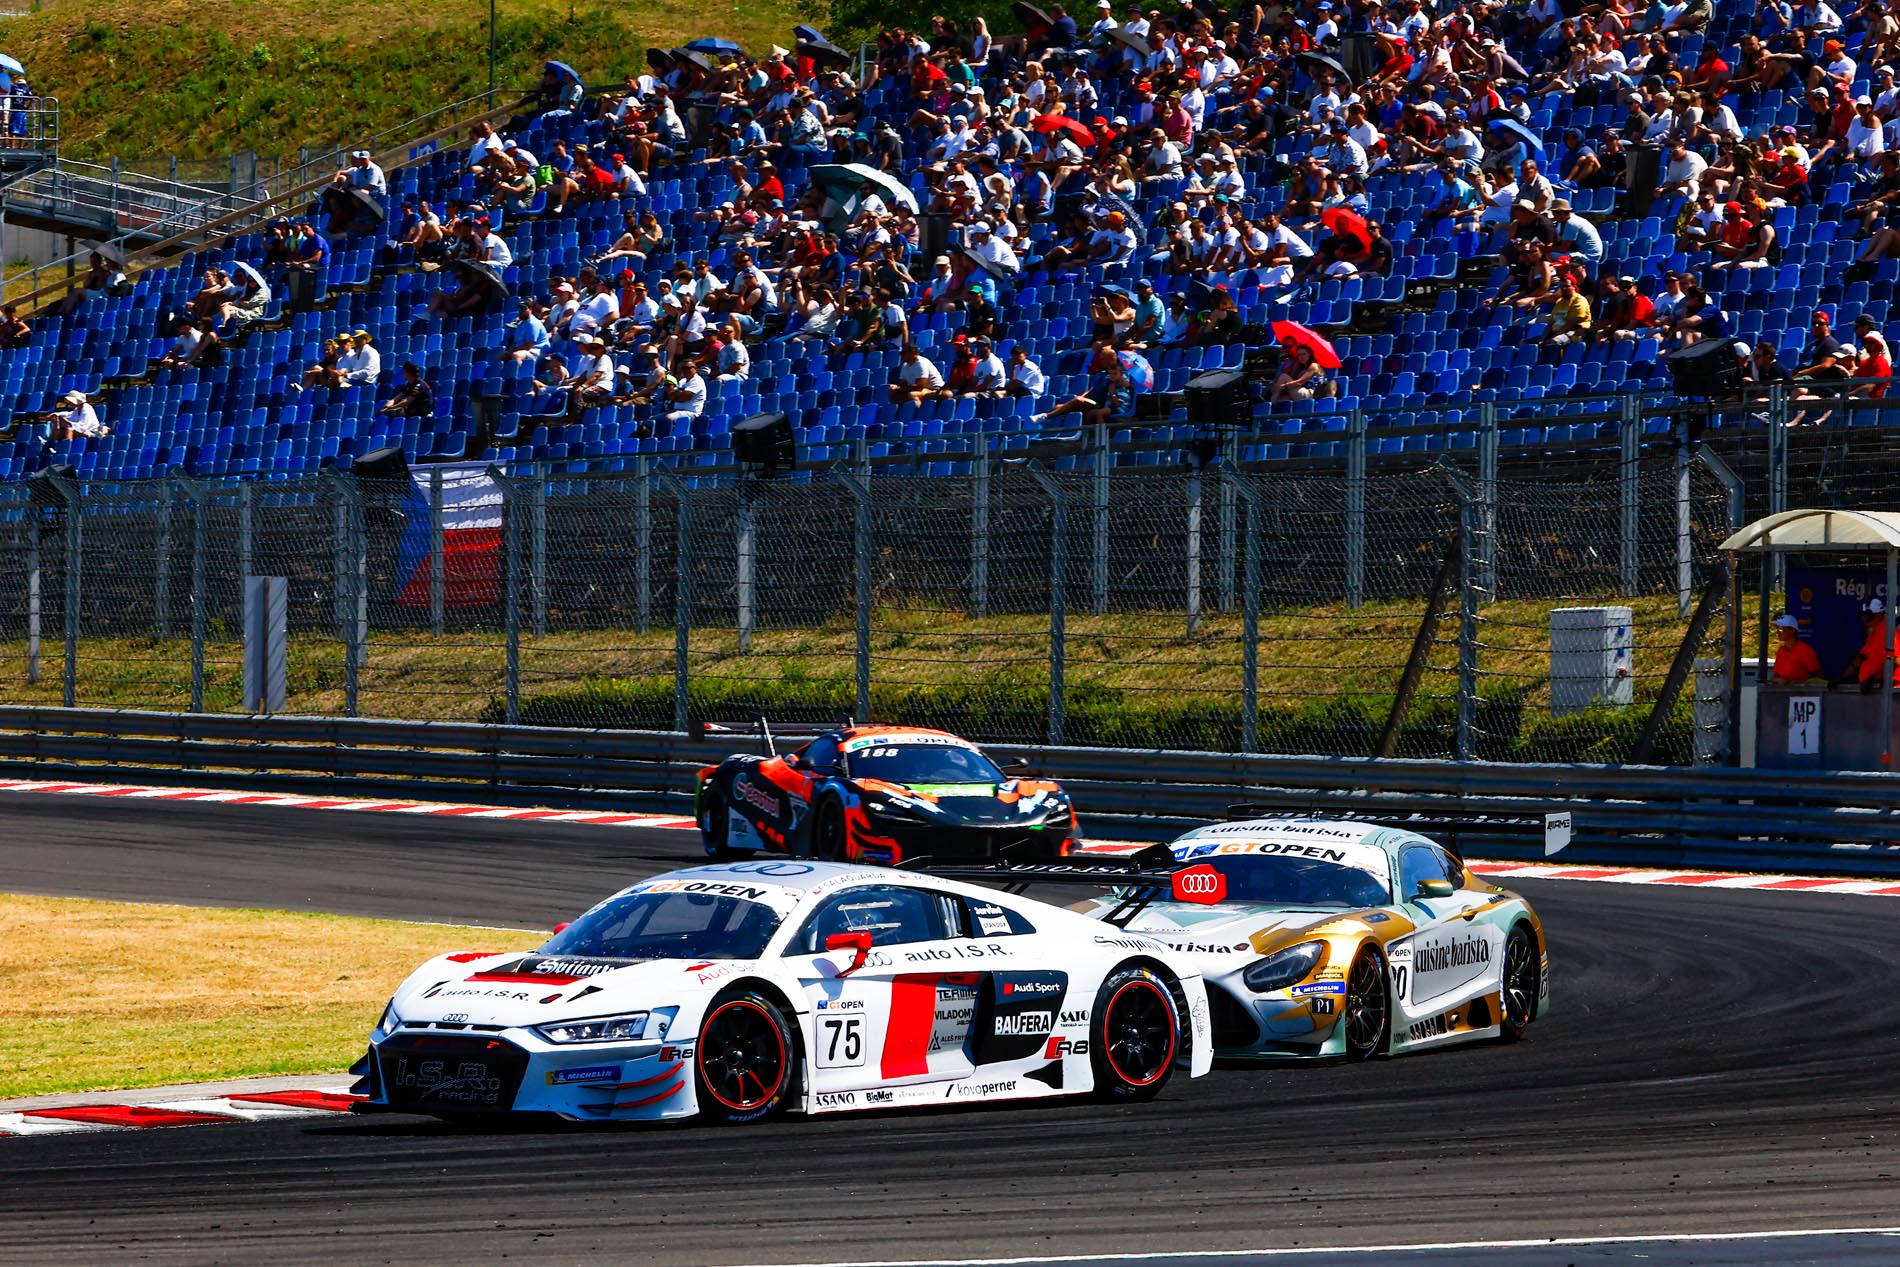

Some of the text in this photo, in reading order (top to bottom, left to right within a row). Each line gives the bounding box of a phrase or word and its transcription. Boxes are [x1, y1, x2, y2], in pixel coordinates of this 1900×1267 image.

[1793, 702, 1815, 723] MP
[1799, 728, 1806, 749] 1
[860, 748, 899, 759] 188
[904, 943, 1013, 963] auto I.S.R.
[1415, 934, 1490, 974] cuisine barista
[1013, 982, 1060, 994] Audi Sport
[1303, 985, 1340, 993] MICHELIN
[995, 1014, 1051, 1034] BAUFERA
[1060, 1010, 1090, 1023] SATO
[824, 1019, 861, 1061] 75
[1055, 1040, 1089, 1055] R8
[669, 1048, 694, 1060] R8
[567, 1070, 613, 1080] MICHELIN
[957, 1080, 1017, 1097] kovoperner
[866, 1090, 893, 1103] BigMat
